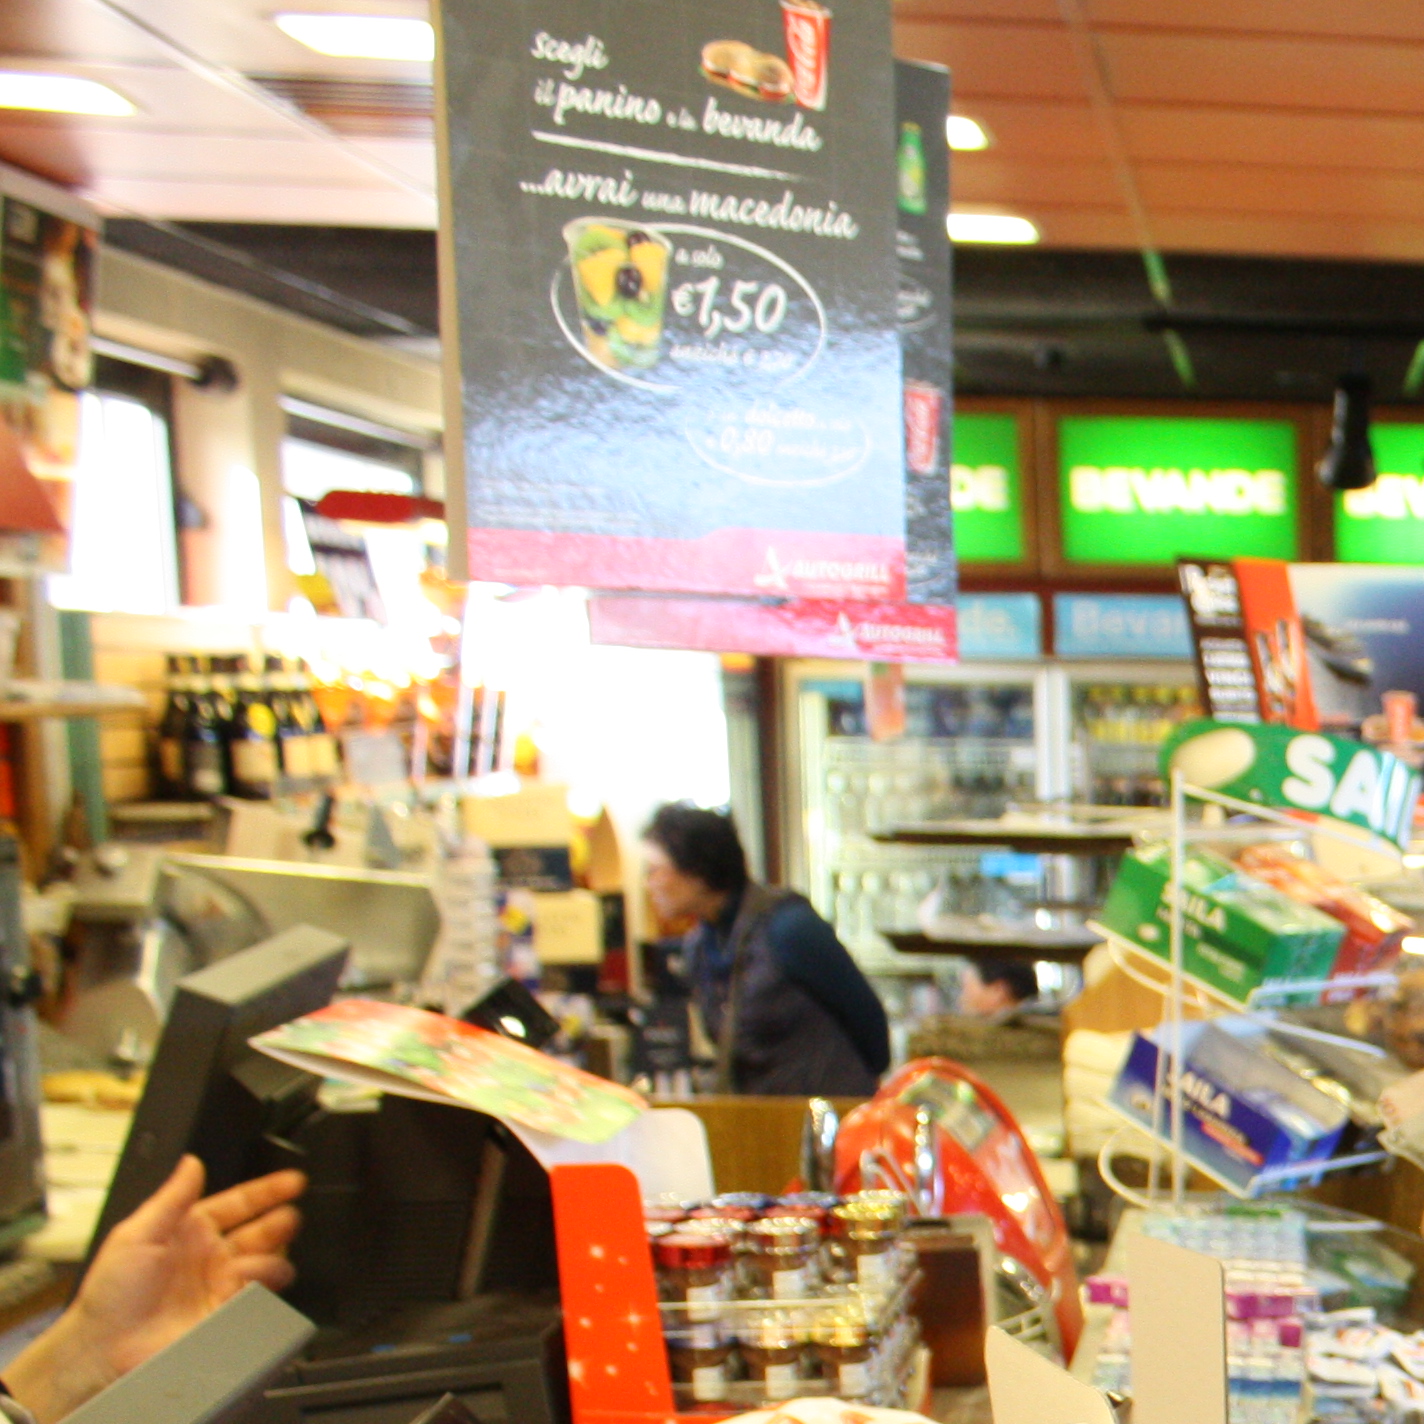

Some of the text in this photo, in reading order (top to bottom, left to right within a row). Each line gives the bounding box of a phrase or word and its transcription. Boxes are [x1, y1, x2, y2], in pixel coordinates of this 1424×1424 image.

[553, 83, 662, 126] panino
[702, 96, 823, 152] bevanda
[689, 190, 860, 241] macedonia
[1069, 467, 1287, 515] BEVANDE
[792, 559, 891, 584] AUTOGRILL
